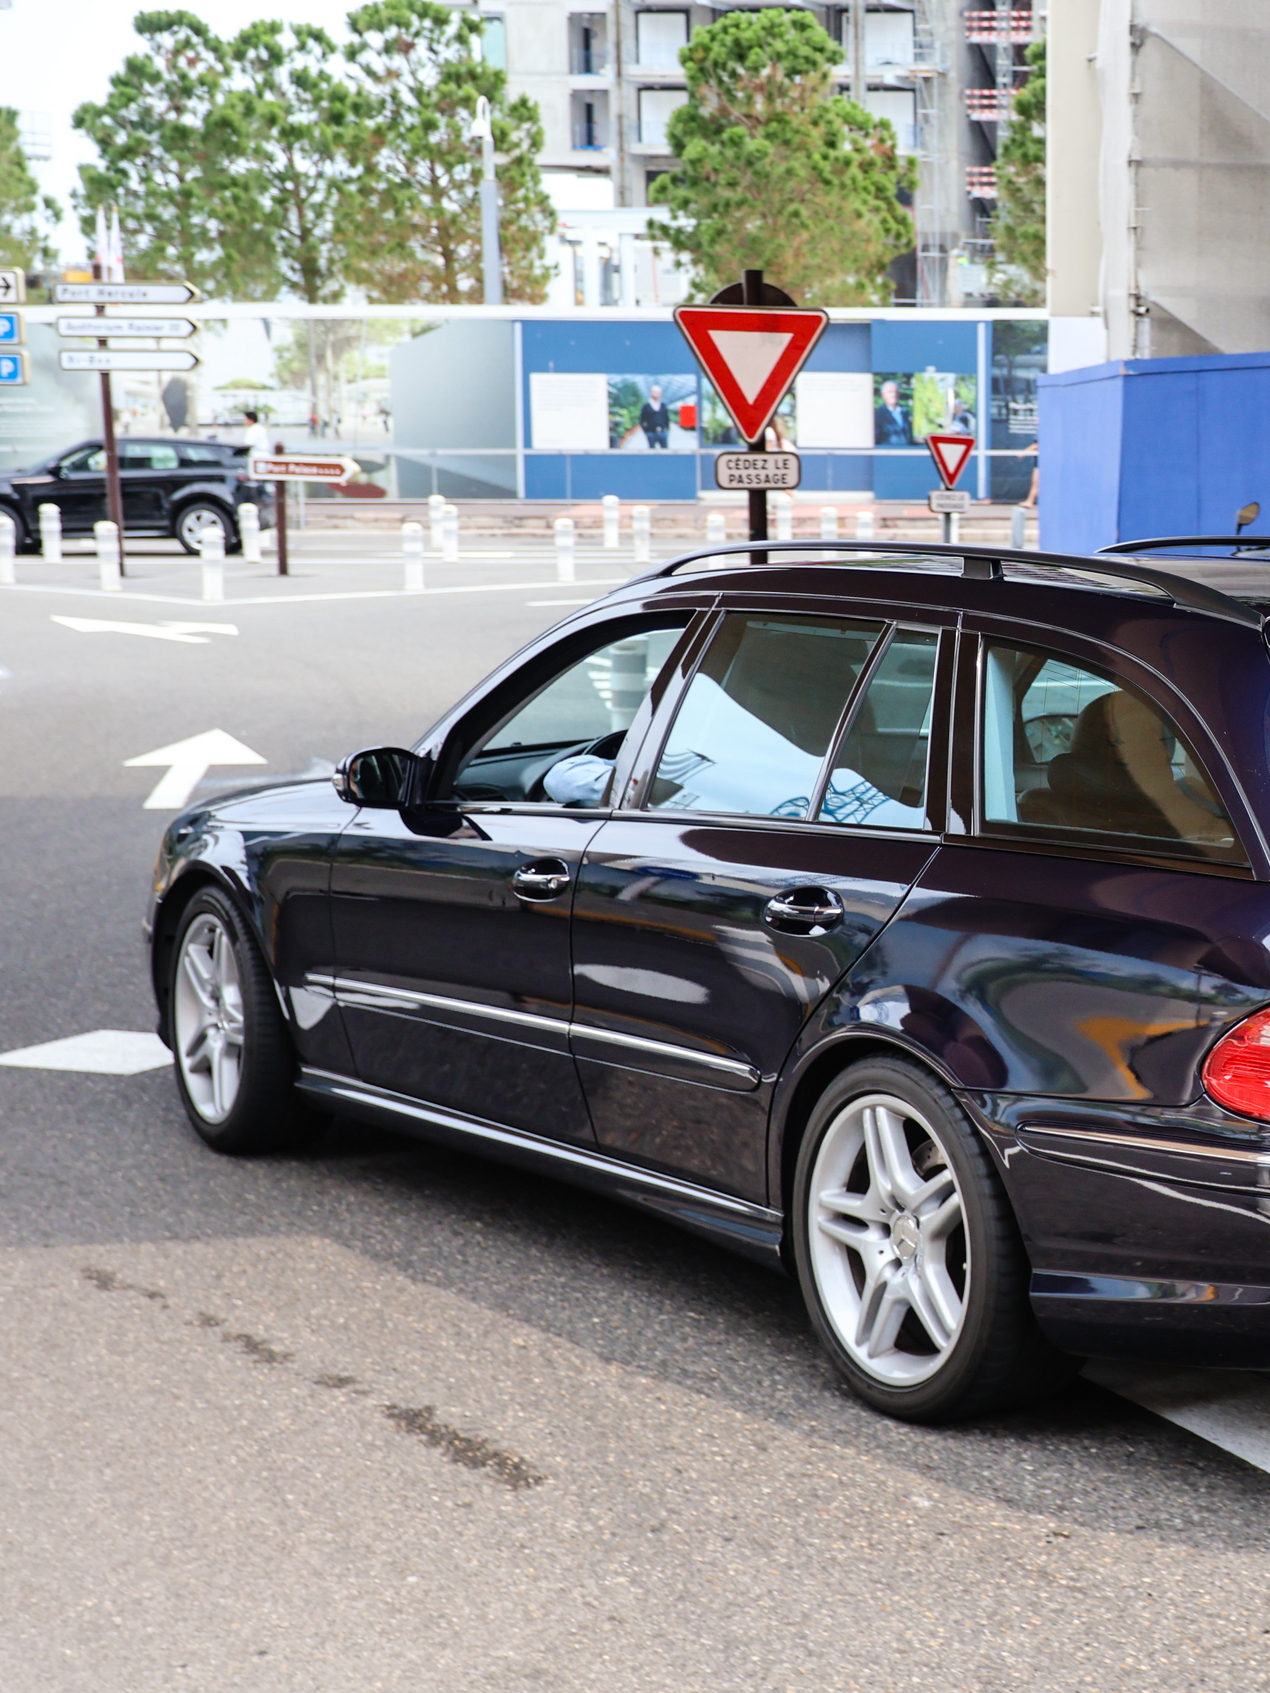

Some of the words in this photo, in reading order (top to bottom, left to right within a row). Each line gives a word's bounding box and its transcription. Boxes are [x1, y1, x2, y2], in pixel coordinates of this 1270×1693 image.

[61, 287, 90, 297] Port
[97, 288, 148, 298] Hercule
[726, 457, 768, 470] CÉDEZ
[775, 459, 790, 470] LE
[728, 473, 789, 485] PASSAGE
